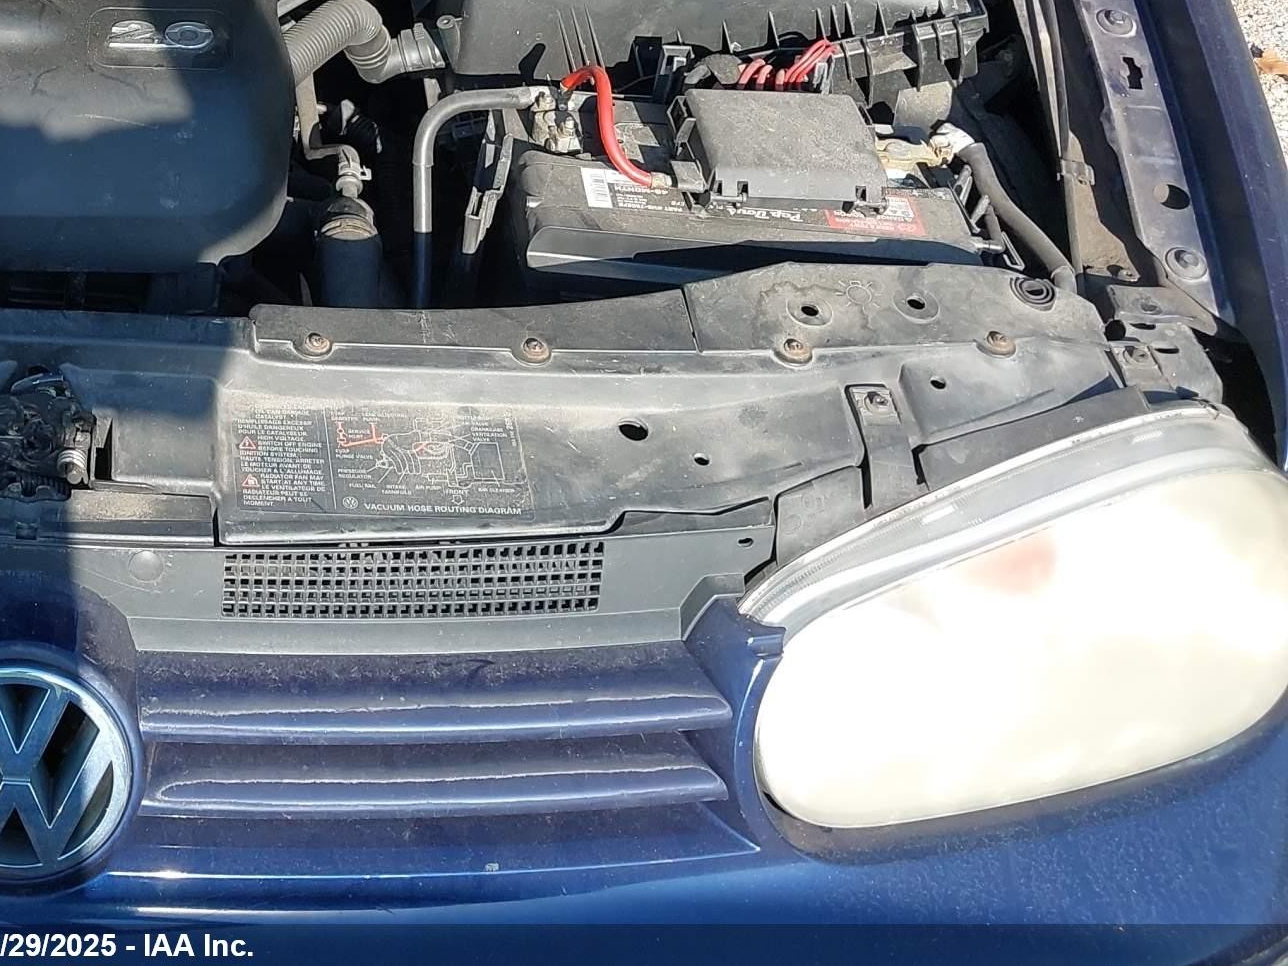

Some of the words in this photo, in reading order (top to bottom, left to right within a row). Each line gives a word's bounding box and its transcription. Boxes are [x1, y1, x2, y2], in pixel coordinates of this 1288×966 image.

[364, 503, 405, 511] VACUUM
[434, 505, 477, 514] ROUTING
[478, 507, 522, 515] DIAGRAM
